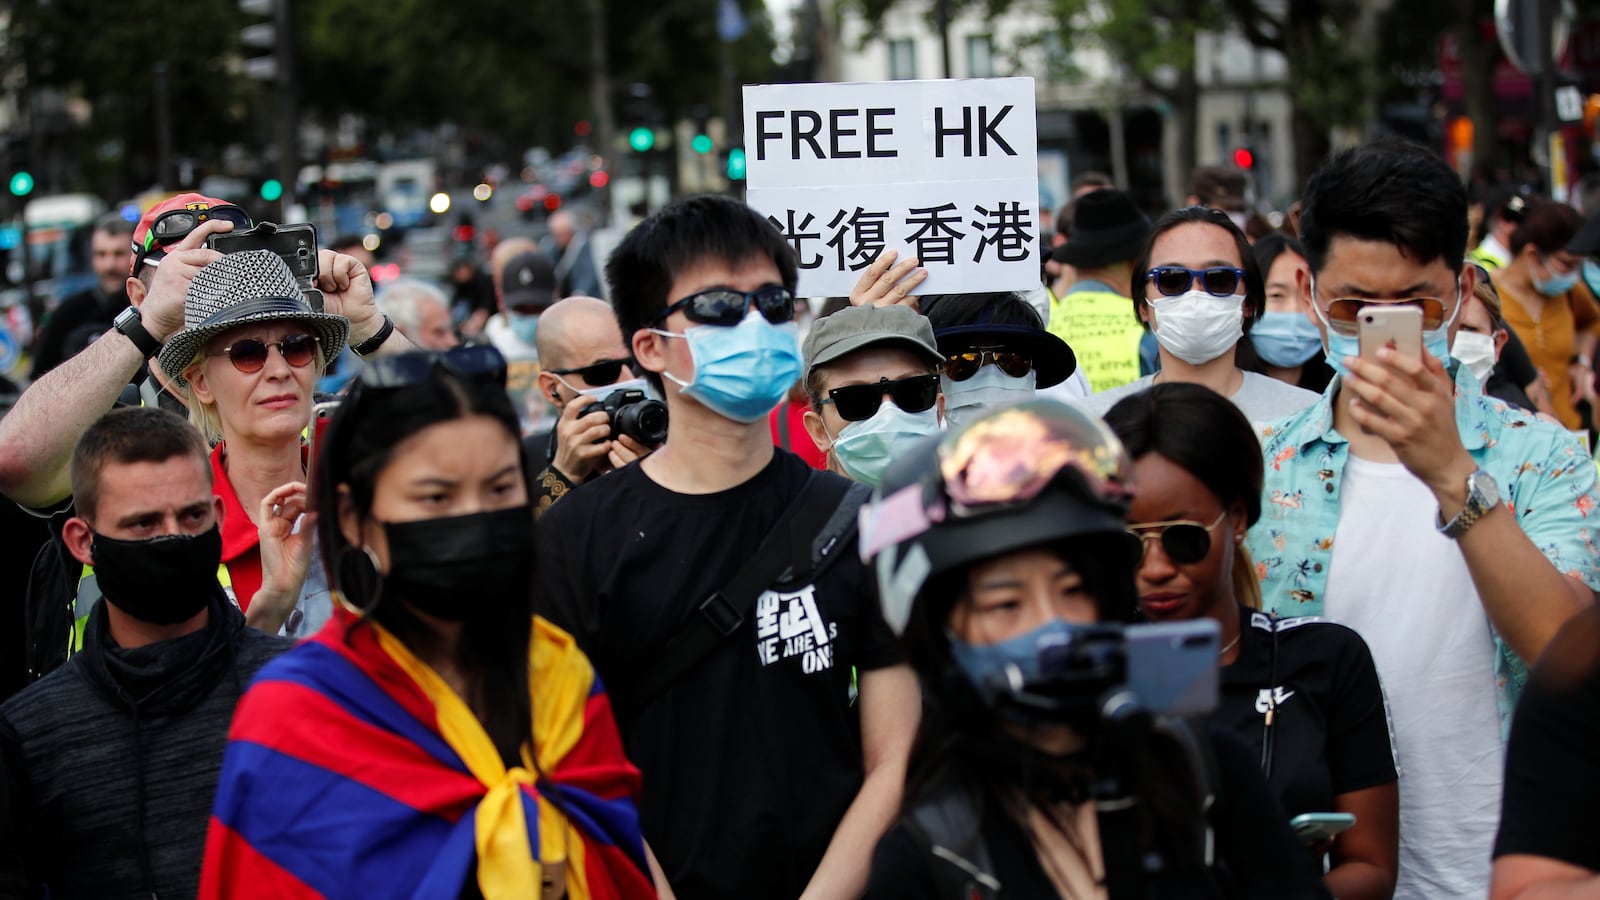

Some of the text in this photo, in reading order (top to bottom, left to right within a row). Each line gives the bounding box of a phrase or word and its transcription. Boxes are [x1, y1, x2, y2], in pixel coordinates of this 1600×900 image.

[756, 105, 1018, 160] FREE HK
[768, 201, 1034, 272] 光復香港
[783, 632, 814, 657] ARE
